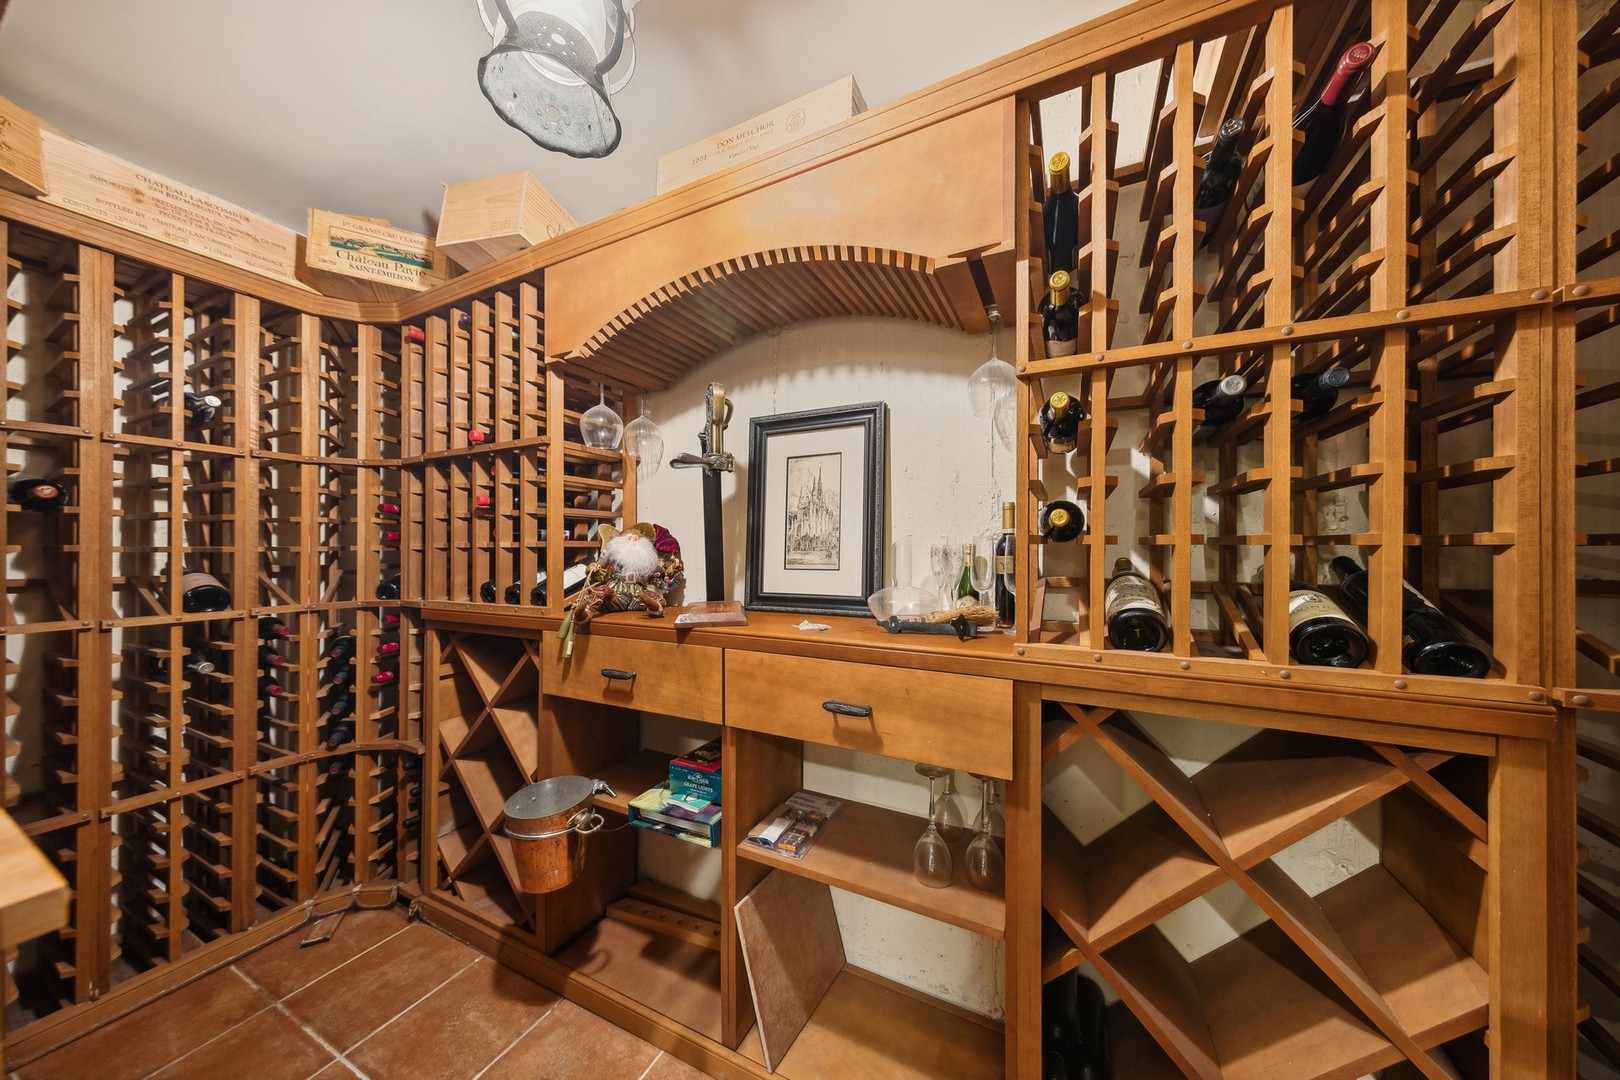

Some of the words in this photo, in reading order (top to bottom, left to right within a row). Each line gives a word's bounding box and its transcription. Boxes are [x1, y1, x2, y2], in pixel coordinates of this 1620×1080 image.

[717, 136, 734, 150] DON
[736, 121, 774, 141] MELCHOR
[62, 196, 108, 216] CONTENTS
[95, 197, 134, 215] BOTTLED
[135, 210, 146, 219] BY
[135, 173, 188, 197] CHATEAU
[189, 194, 250, 223] LASCOMBES
[352, 223, 381, 235] GRAND
[382, 230, 398, 240] CRU
[394, 261, 427, 278] Pavie
